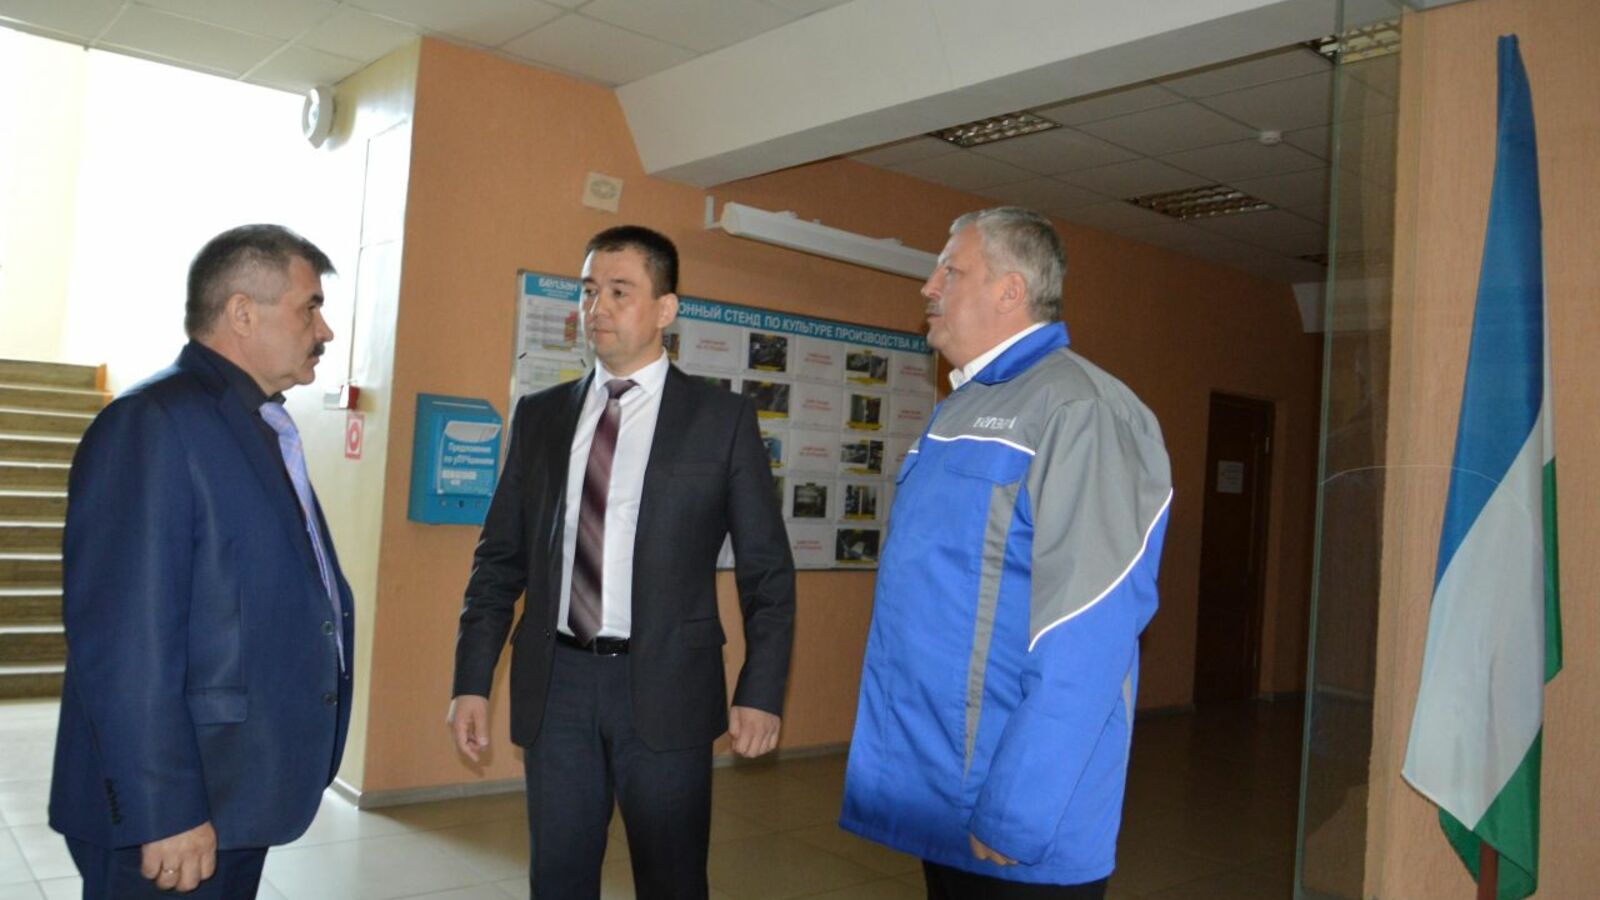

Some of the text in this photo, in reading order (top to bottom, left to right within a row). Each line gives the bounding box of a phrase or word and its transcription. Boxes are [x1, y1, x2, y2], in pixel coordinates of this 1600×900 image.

[679, 303, 721, 319] ОННЫЙ
[724, 309, 761, 326] СТЕНД
[764, 315, 780, 329] ПО
[782, 318, 833, 336] КУЛЬТУРЕ
[834, 327, 911, 349] ПРОИЗВОДСТВА
[911, 338, 919, 350] И
